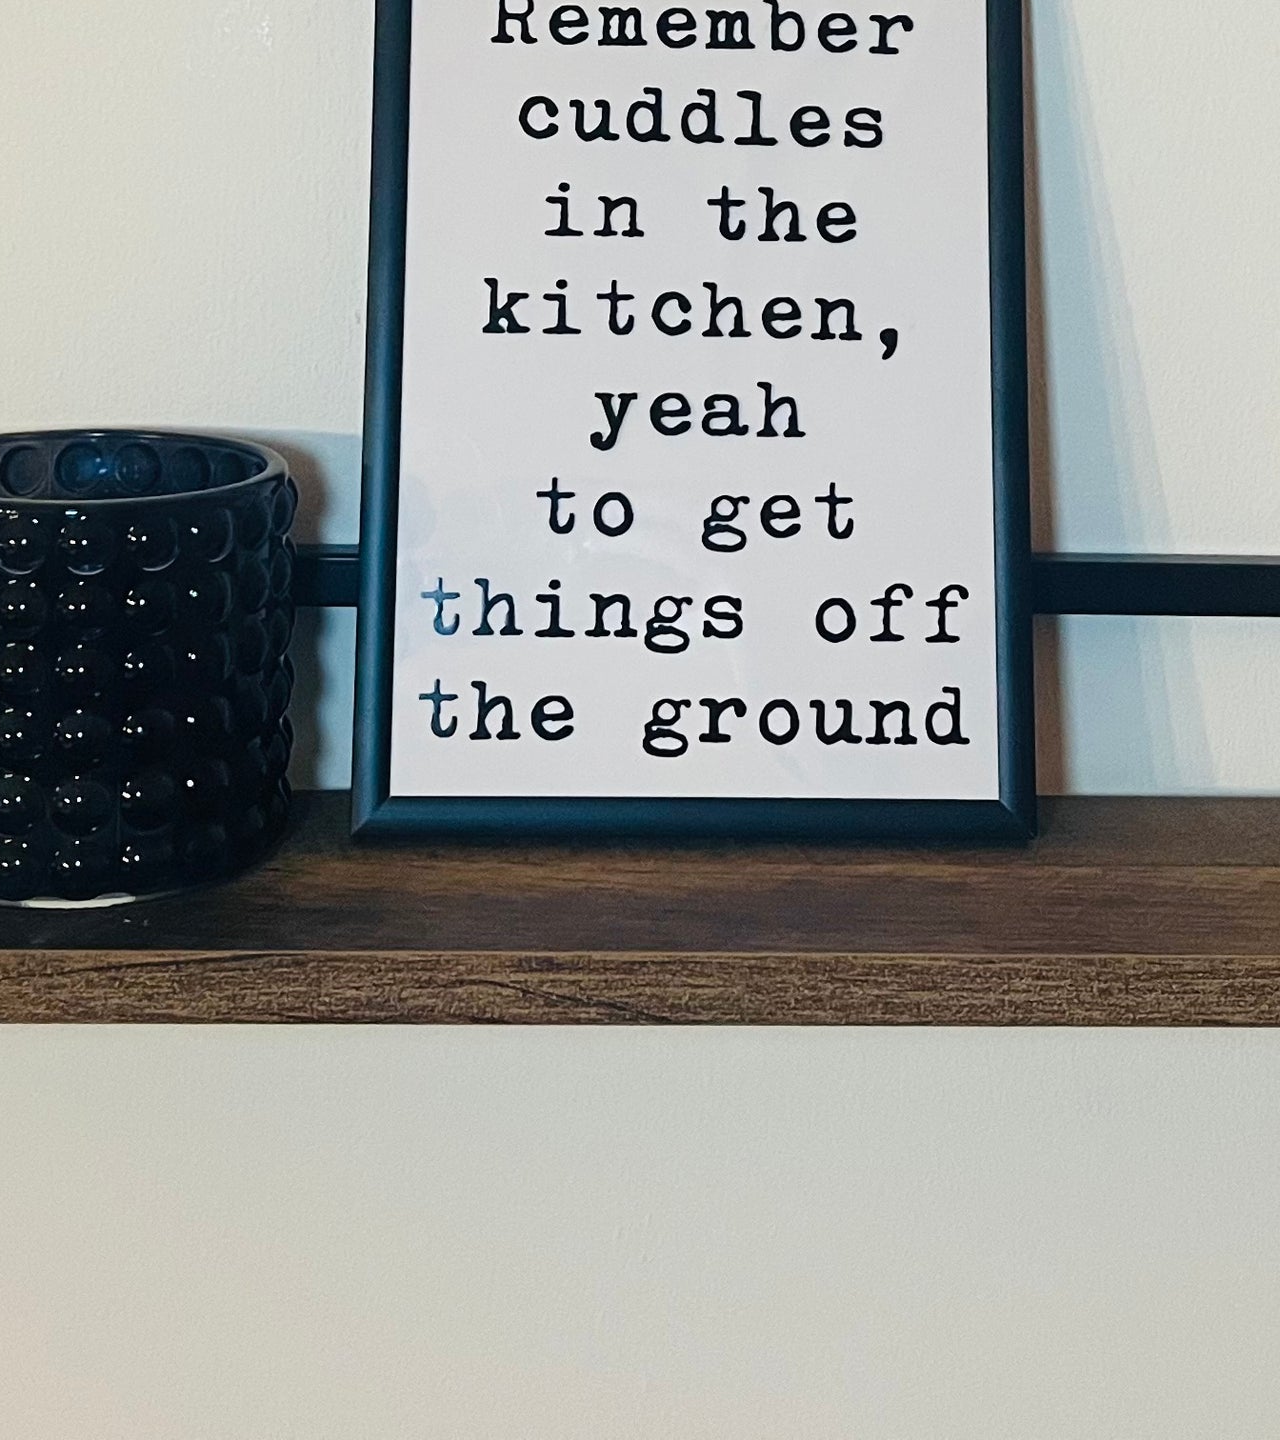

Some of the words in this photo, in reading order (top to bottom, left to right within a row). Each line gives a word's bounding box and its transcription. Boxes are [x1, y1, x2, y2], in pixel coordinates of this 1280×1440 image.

[517, 85, 885, 150] cuddles
[543, 180, 646, 239] in
[705, 184, 858, 245] the
[480, 276, 900, 362] kitchen,
[588, 380, 808, 453] yeah
[534, 475, 636, 539] to
[700, 480, 856, 555] get
[419, 575, 745, 656] things
[814, 581, 971, 645] off
[417, 677, 576, 743] the
[641, 684, 972, 759] ground
